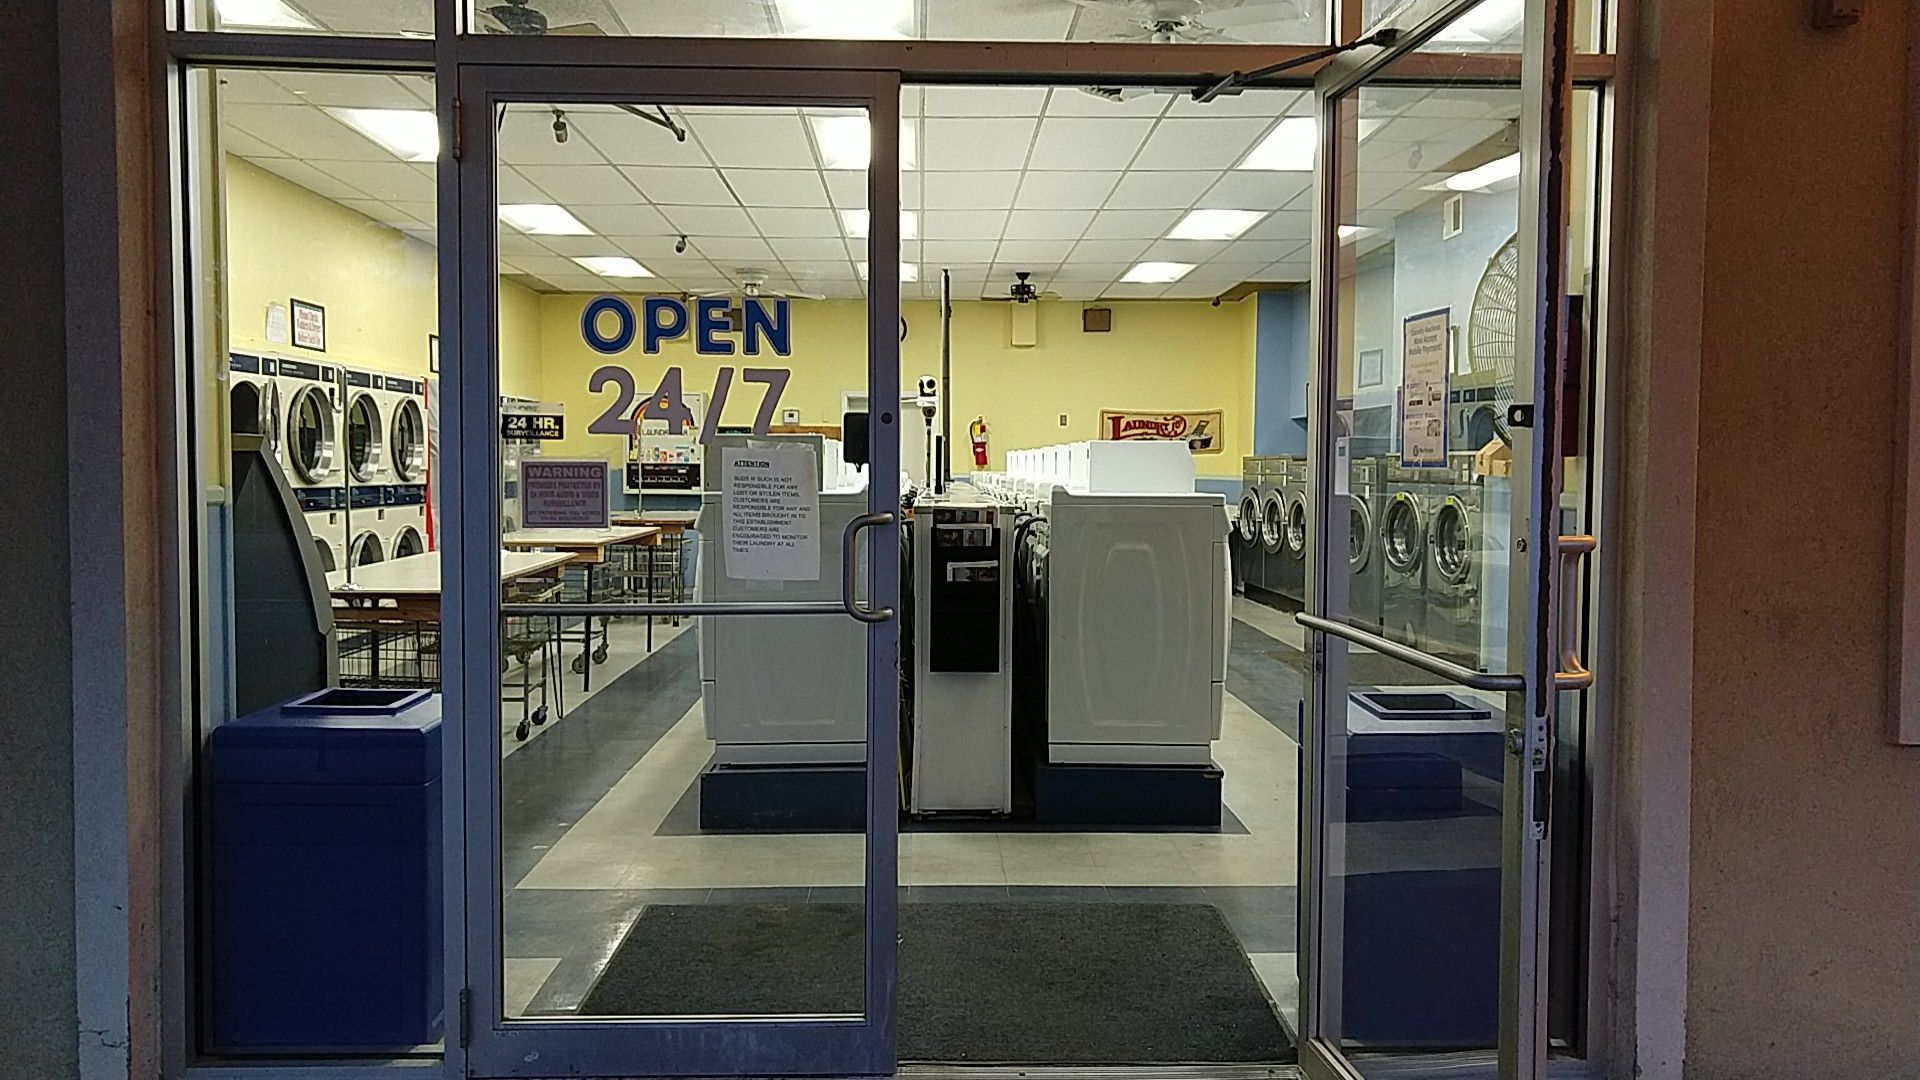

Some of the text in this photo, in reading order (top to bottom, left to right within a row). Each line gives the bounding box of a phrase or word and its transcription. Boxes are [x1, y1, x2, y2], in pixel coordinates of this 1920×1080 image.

[581, 295, 791, 356] OPEN
[587, 366, 791, 445] 24/7
[507, 416, 560, 430] 24 HR.
[733, 460, 770, 468] ATTENTION
[527, 466, 602, 478] WARNING
